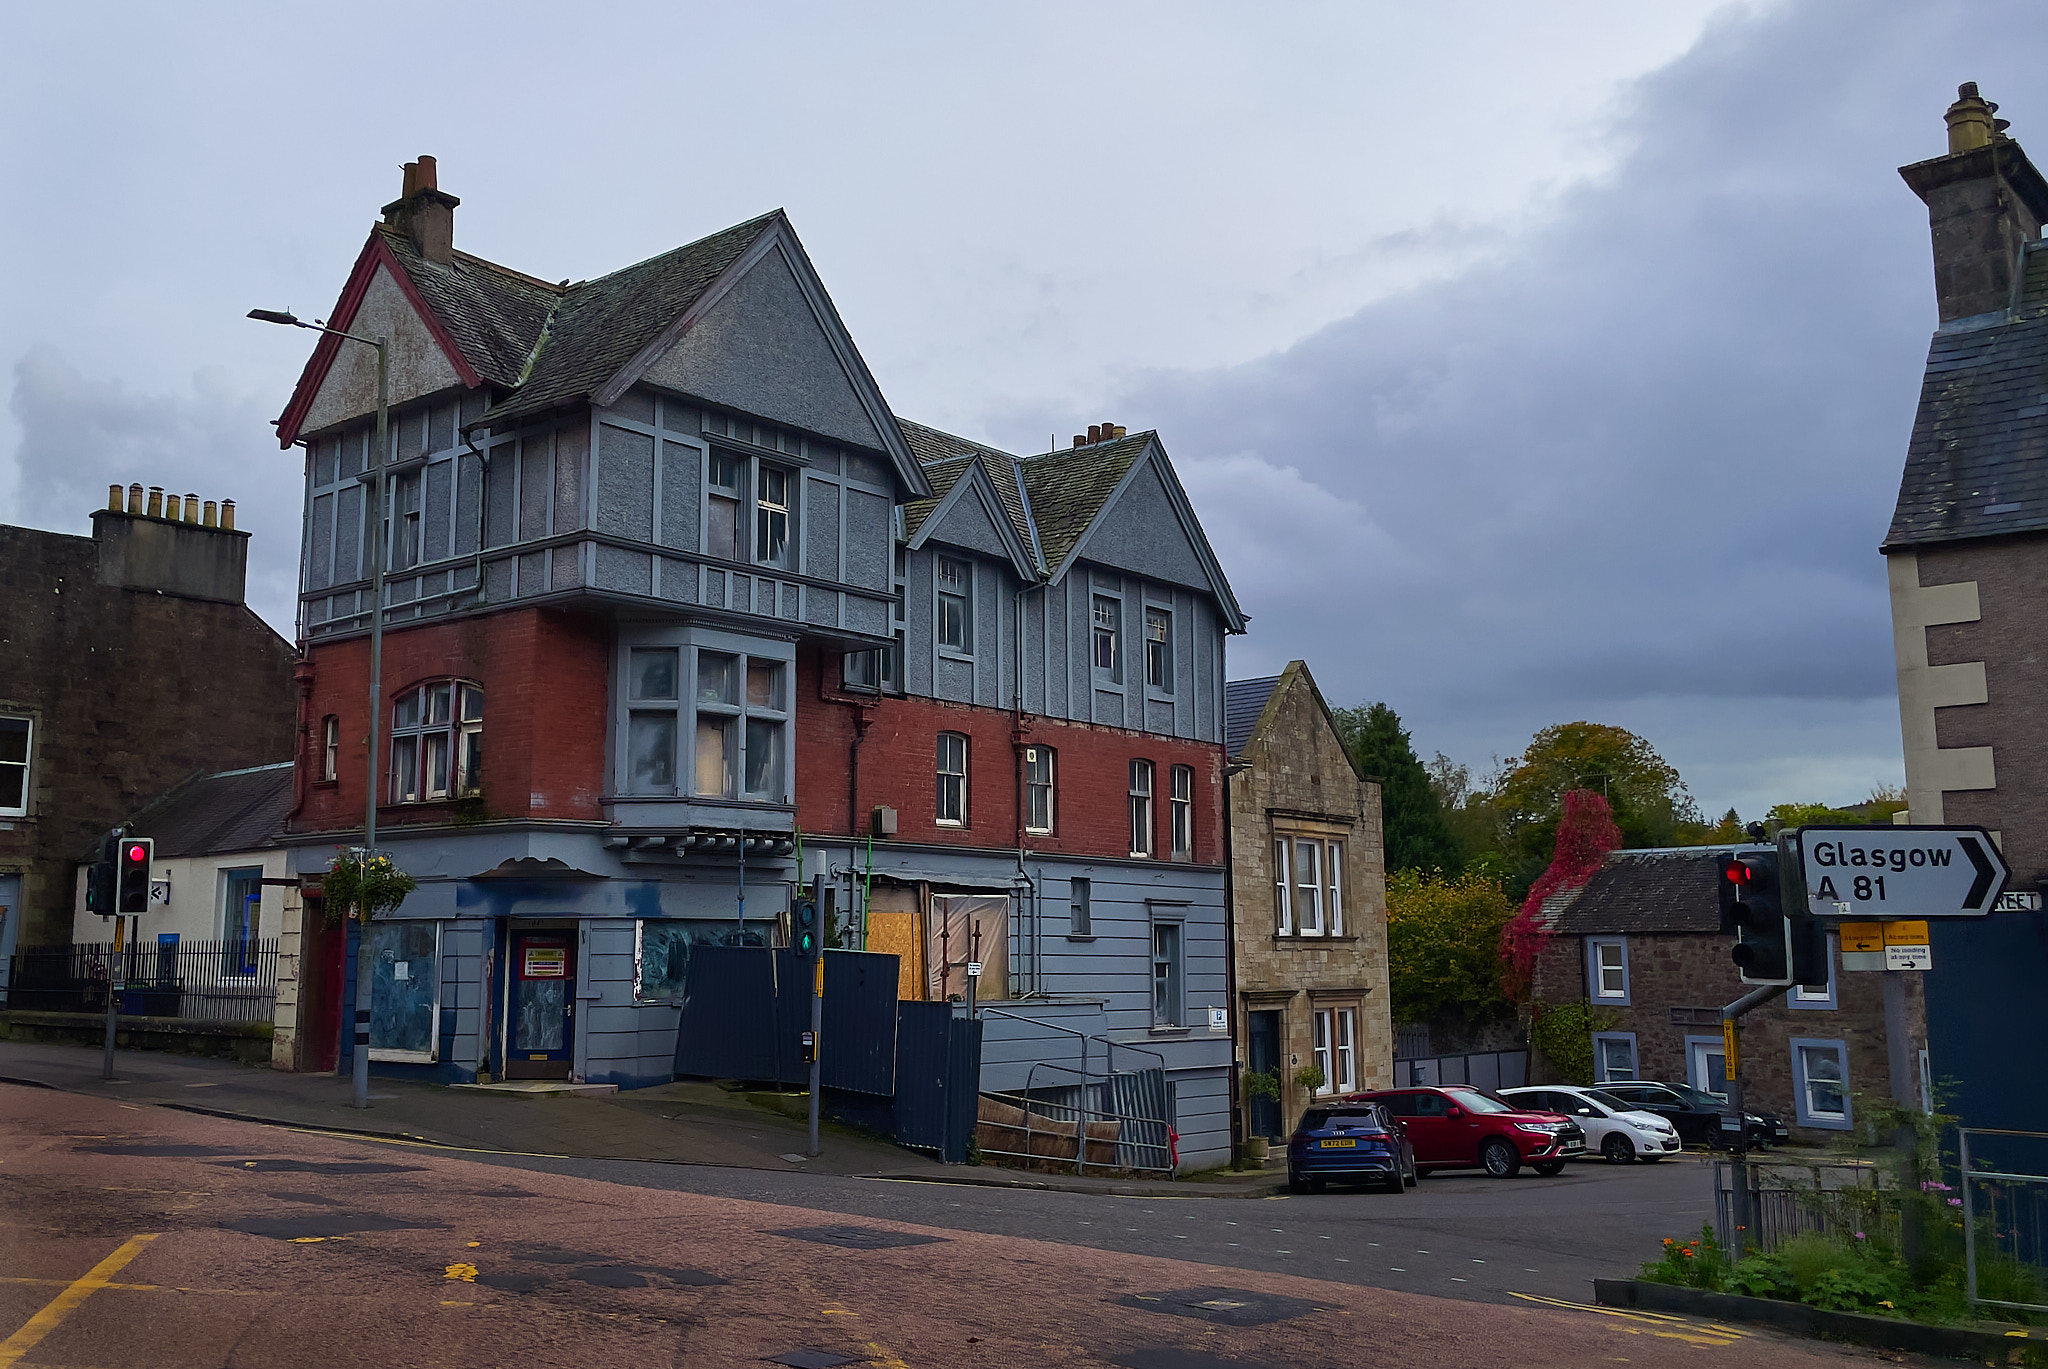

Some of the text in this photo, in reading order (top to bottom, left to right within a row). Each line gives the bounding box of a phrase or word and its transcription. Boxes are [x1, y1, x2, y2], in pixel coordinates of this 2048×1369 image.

[1813, 841, 1952, 873] Glasgow
[1816, 875, 1886, 901] A 81
[1994, 893, 2037, 910] REET
